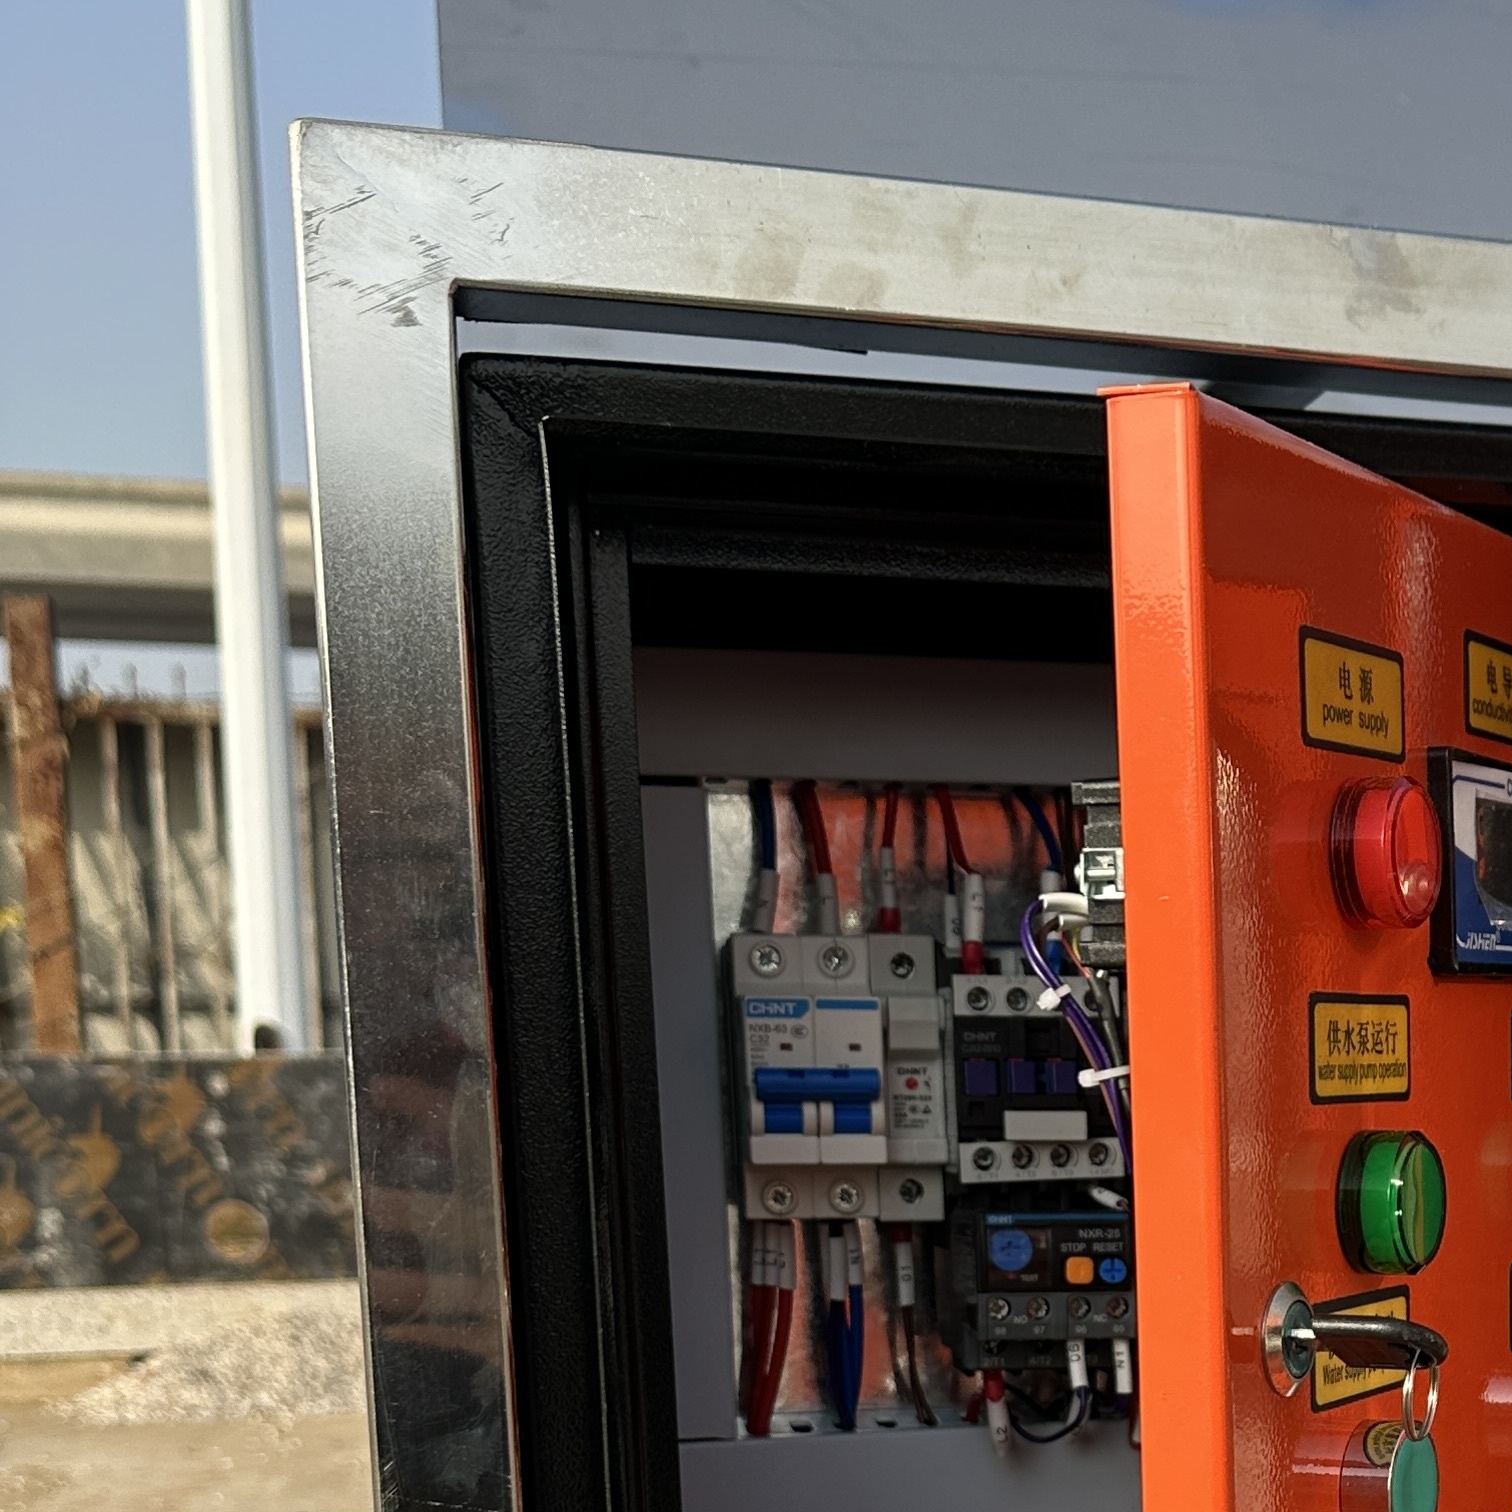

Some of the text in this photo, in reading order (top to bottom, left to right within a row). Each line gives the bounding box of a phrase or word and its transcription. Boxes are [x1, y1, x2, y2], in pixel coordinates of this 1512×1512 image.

[1338, 660, 1375, 706] 电源
[1322, 703, 1389, 739] power supply
[750, 1001, 797, 1015] CHNT
[749, 1023, 788, 1034] NXB-63
[1327, 1018, 1398, 1057] 供水泵运行
[1359, 1063, 1378, 1085] pump
[1078, 1228, 1120, 1239] NXR-25
[1060, 1242, 1087, 1252] STOP
[1092, 1241, 1124, 1252] RESET
[1323, 1363, 1344, 1386] Water
